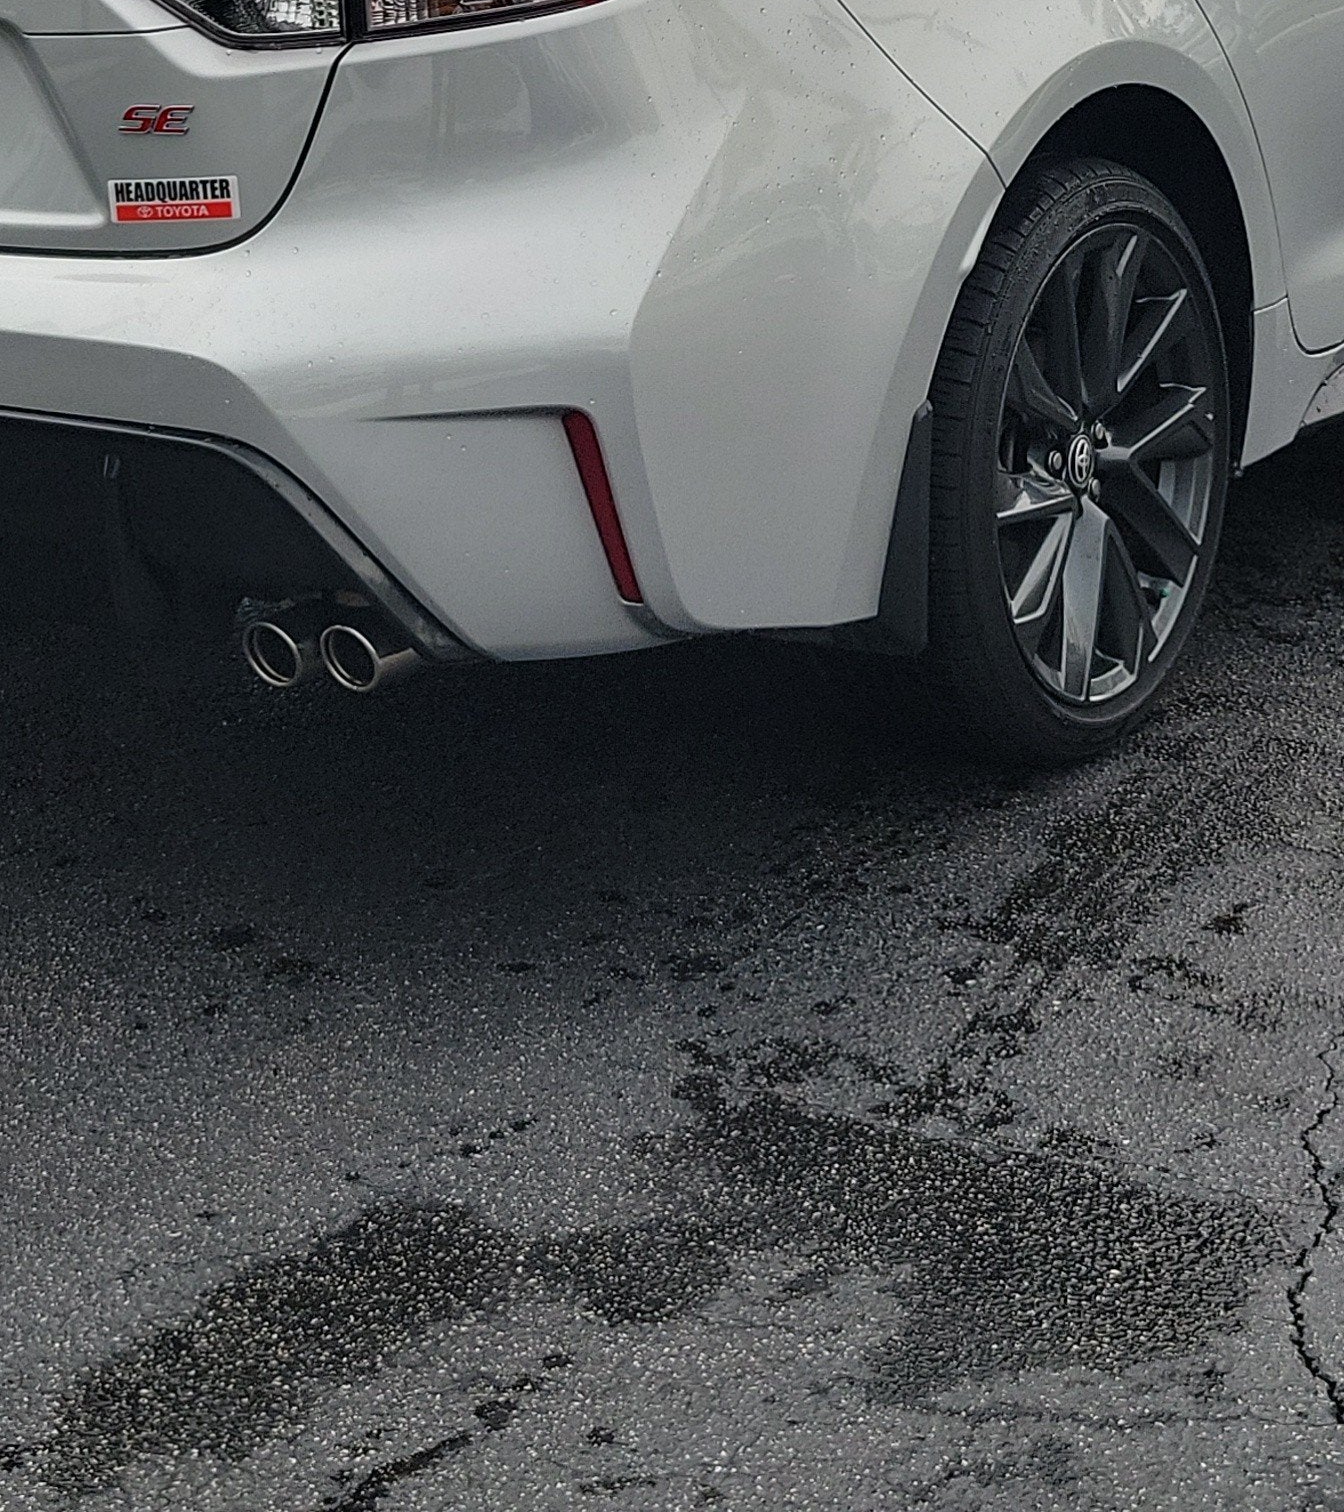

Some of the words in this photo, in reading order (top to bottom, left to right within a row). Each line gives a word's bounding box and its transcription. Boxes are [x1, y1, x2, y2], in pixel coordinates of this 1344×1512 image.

[118, 104, 195, 136] SE
[114, 178, 231, 203] HEADQUARTER
[155, 205, 209, 218] TOYOTA
